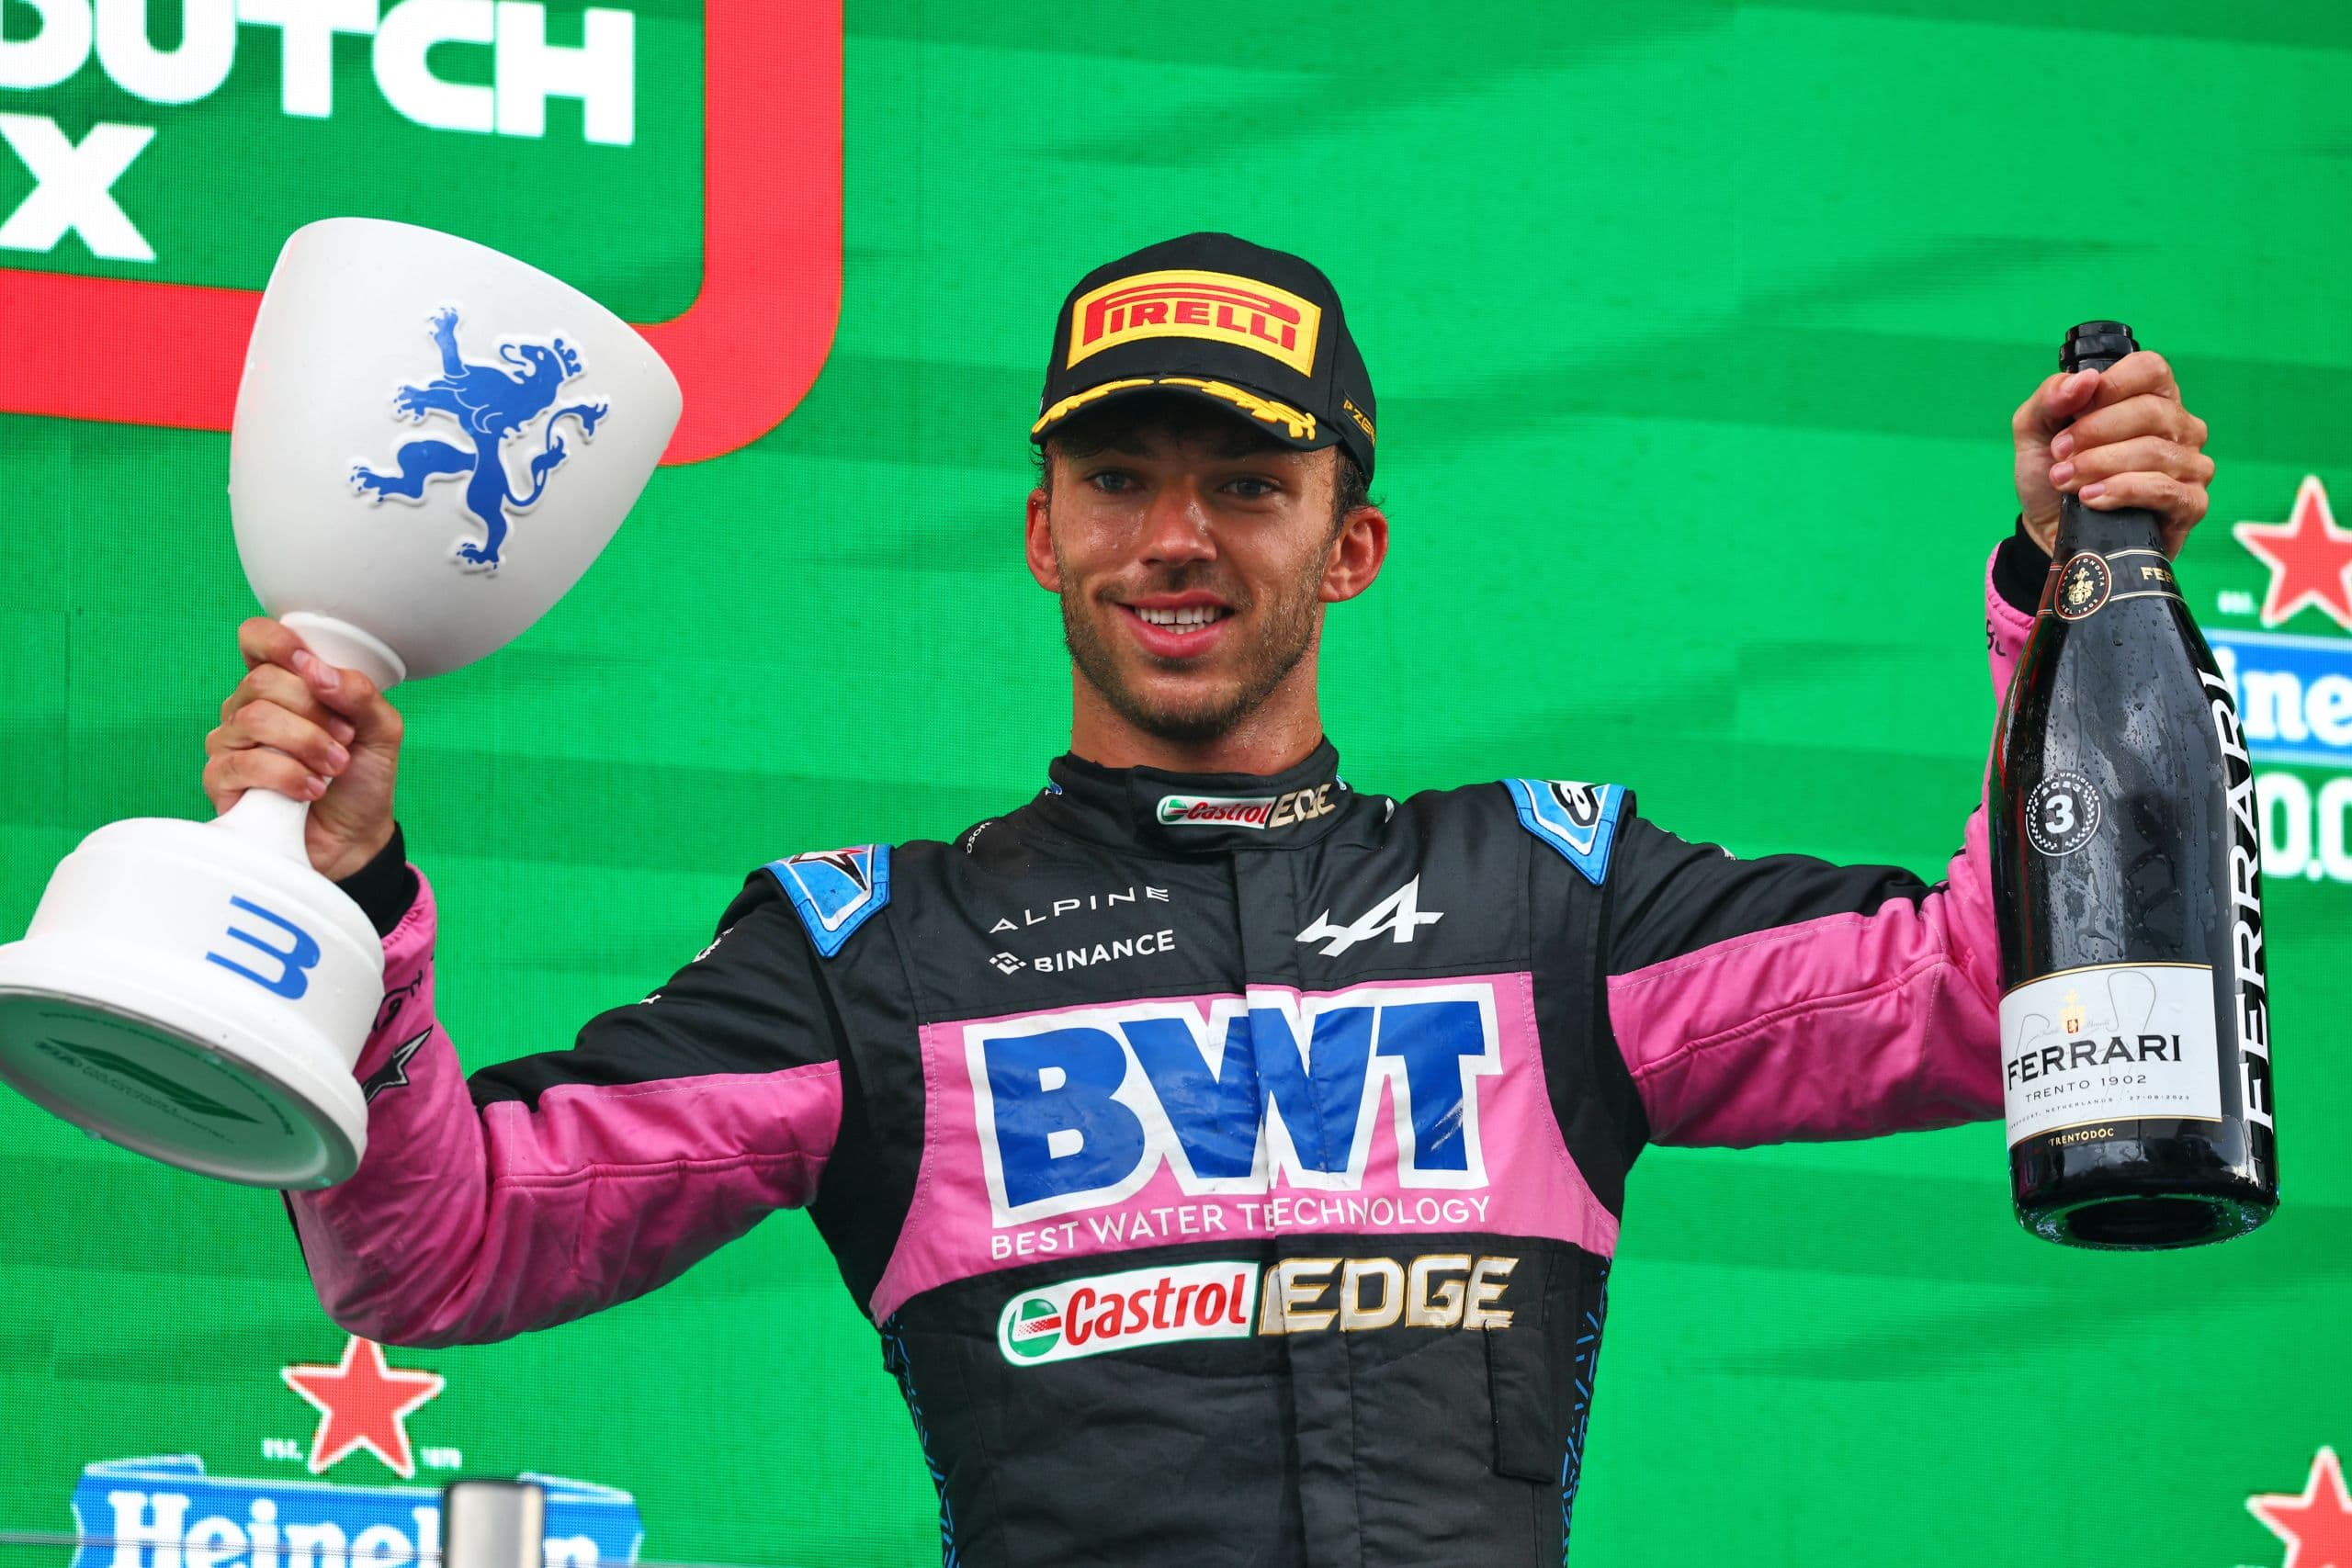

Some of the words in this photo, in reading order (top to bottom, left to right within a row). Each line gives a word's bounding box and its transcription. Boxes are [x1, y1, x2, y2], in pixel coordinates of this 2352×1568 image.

[1083, 282, 1301, 351] PIRELLI
[1185, 802, 1272, 824] Castrol
[2045, 795, 2075, 834] 3
[989, 886, 1170, 933] ALPINE
[2196, 669, 2274, 1134] FERRARI
[205, 895, 321, 999] 3
[1035, 930, 1175, 972] BINANCE
[2007, 1034, 2182, 1090] FERRARI
[2025, 1079, 2090, 1103] TRENTO
[2101, 1074, 2146, 1087] 1902
[983, 1000, 1486, 1209] BWT
[2049, 1127, 2115, 1146] TRENTODOC
[991, 1221, 1079, 1259] BEST
[1088, 1202, 1225, 1239] WATER
[1065, 1273, 1248, 1347] Castrol
[1258, 1253, 1520, 1337] EDGE
